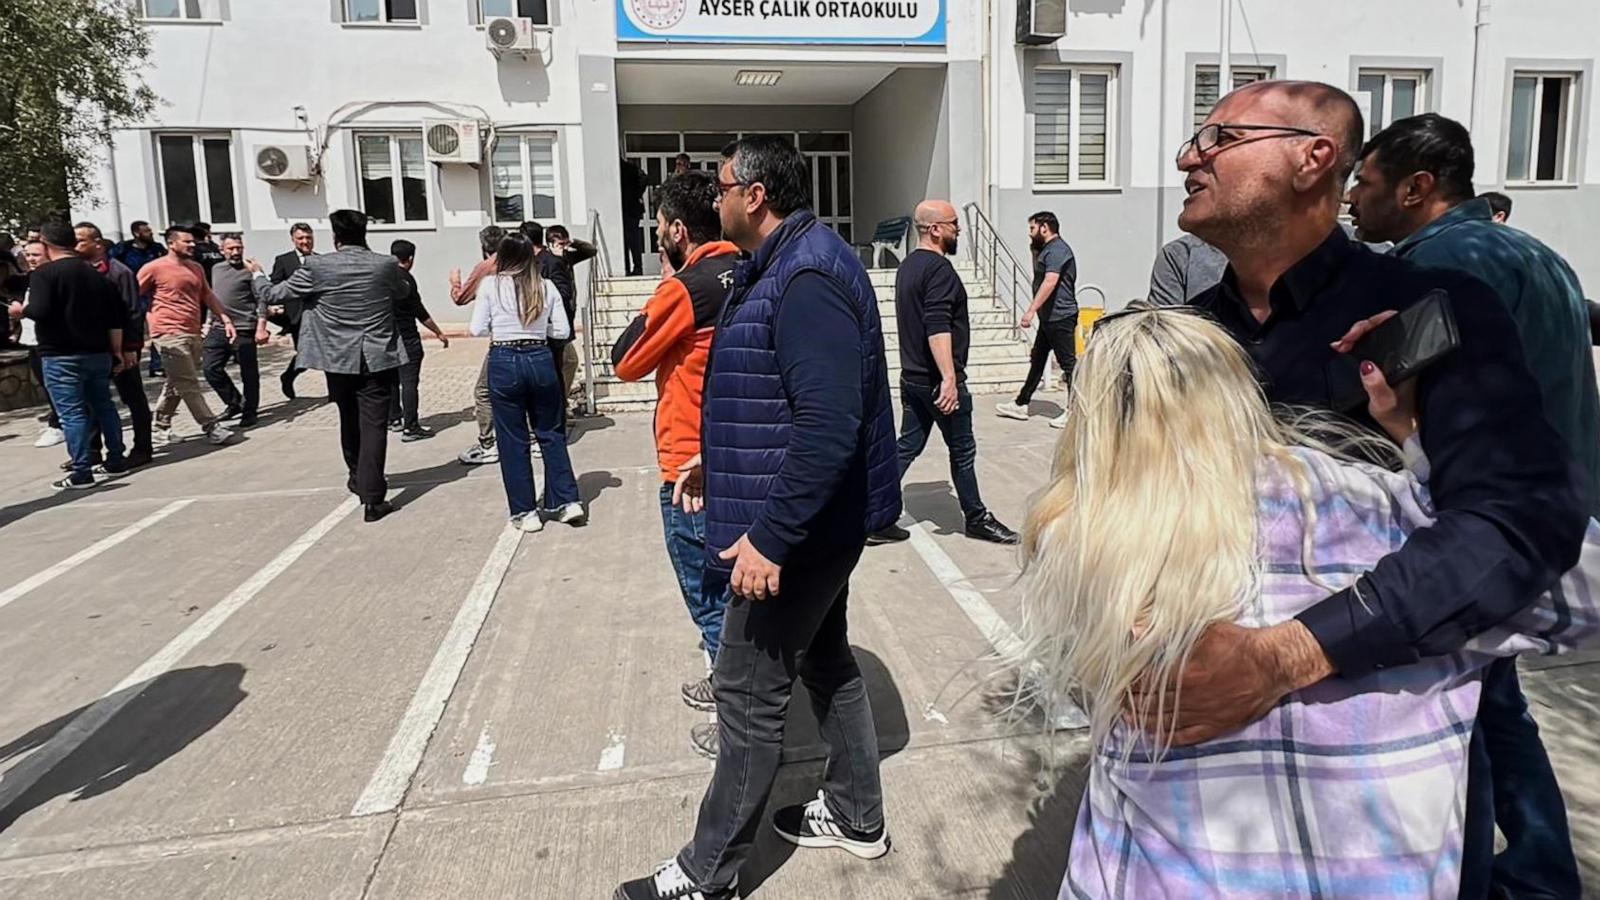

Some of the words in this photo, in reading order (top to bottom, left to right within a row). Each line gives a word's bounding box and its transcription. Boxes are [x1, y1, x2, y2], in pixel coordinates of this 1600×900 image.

[699, 0, 754, 16] AYSER
[759, 0, 810, 19] ÇALIK
[815, 1, 918, 18] ORTAOKULU
